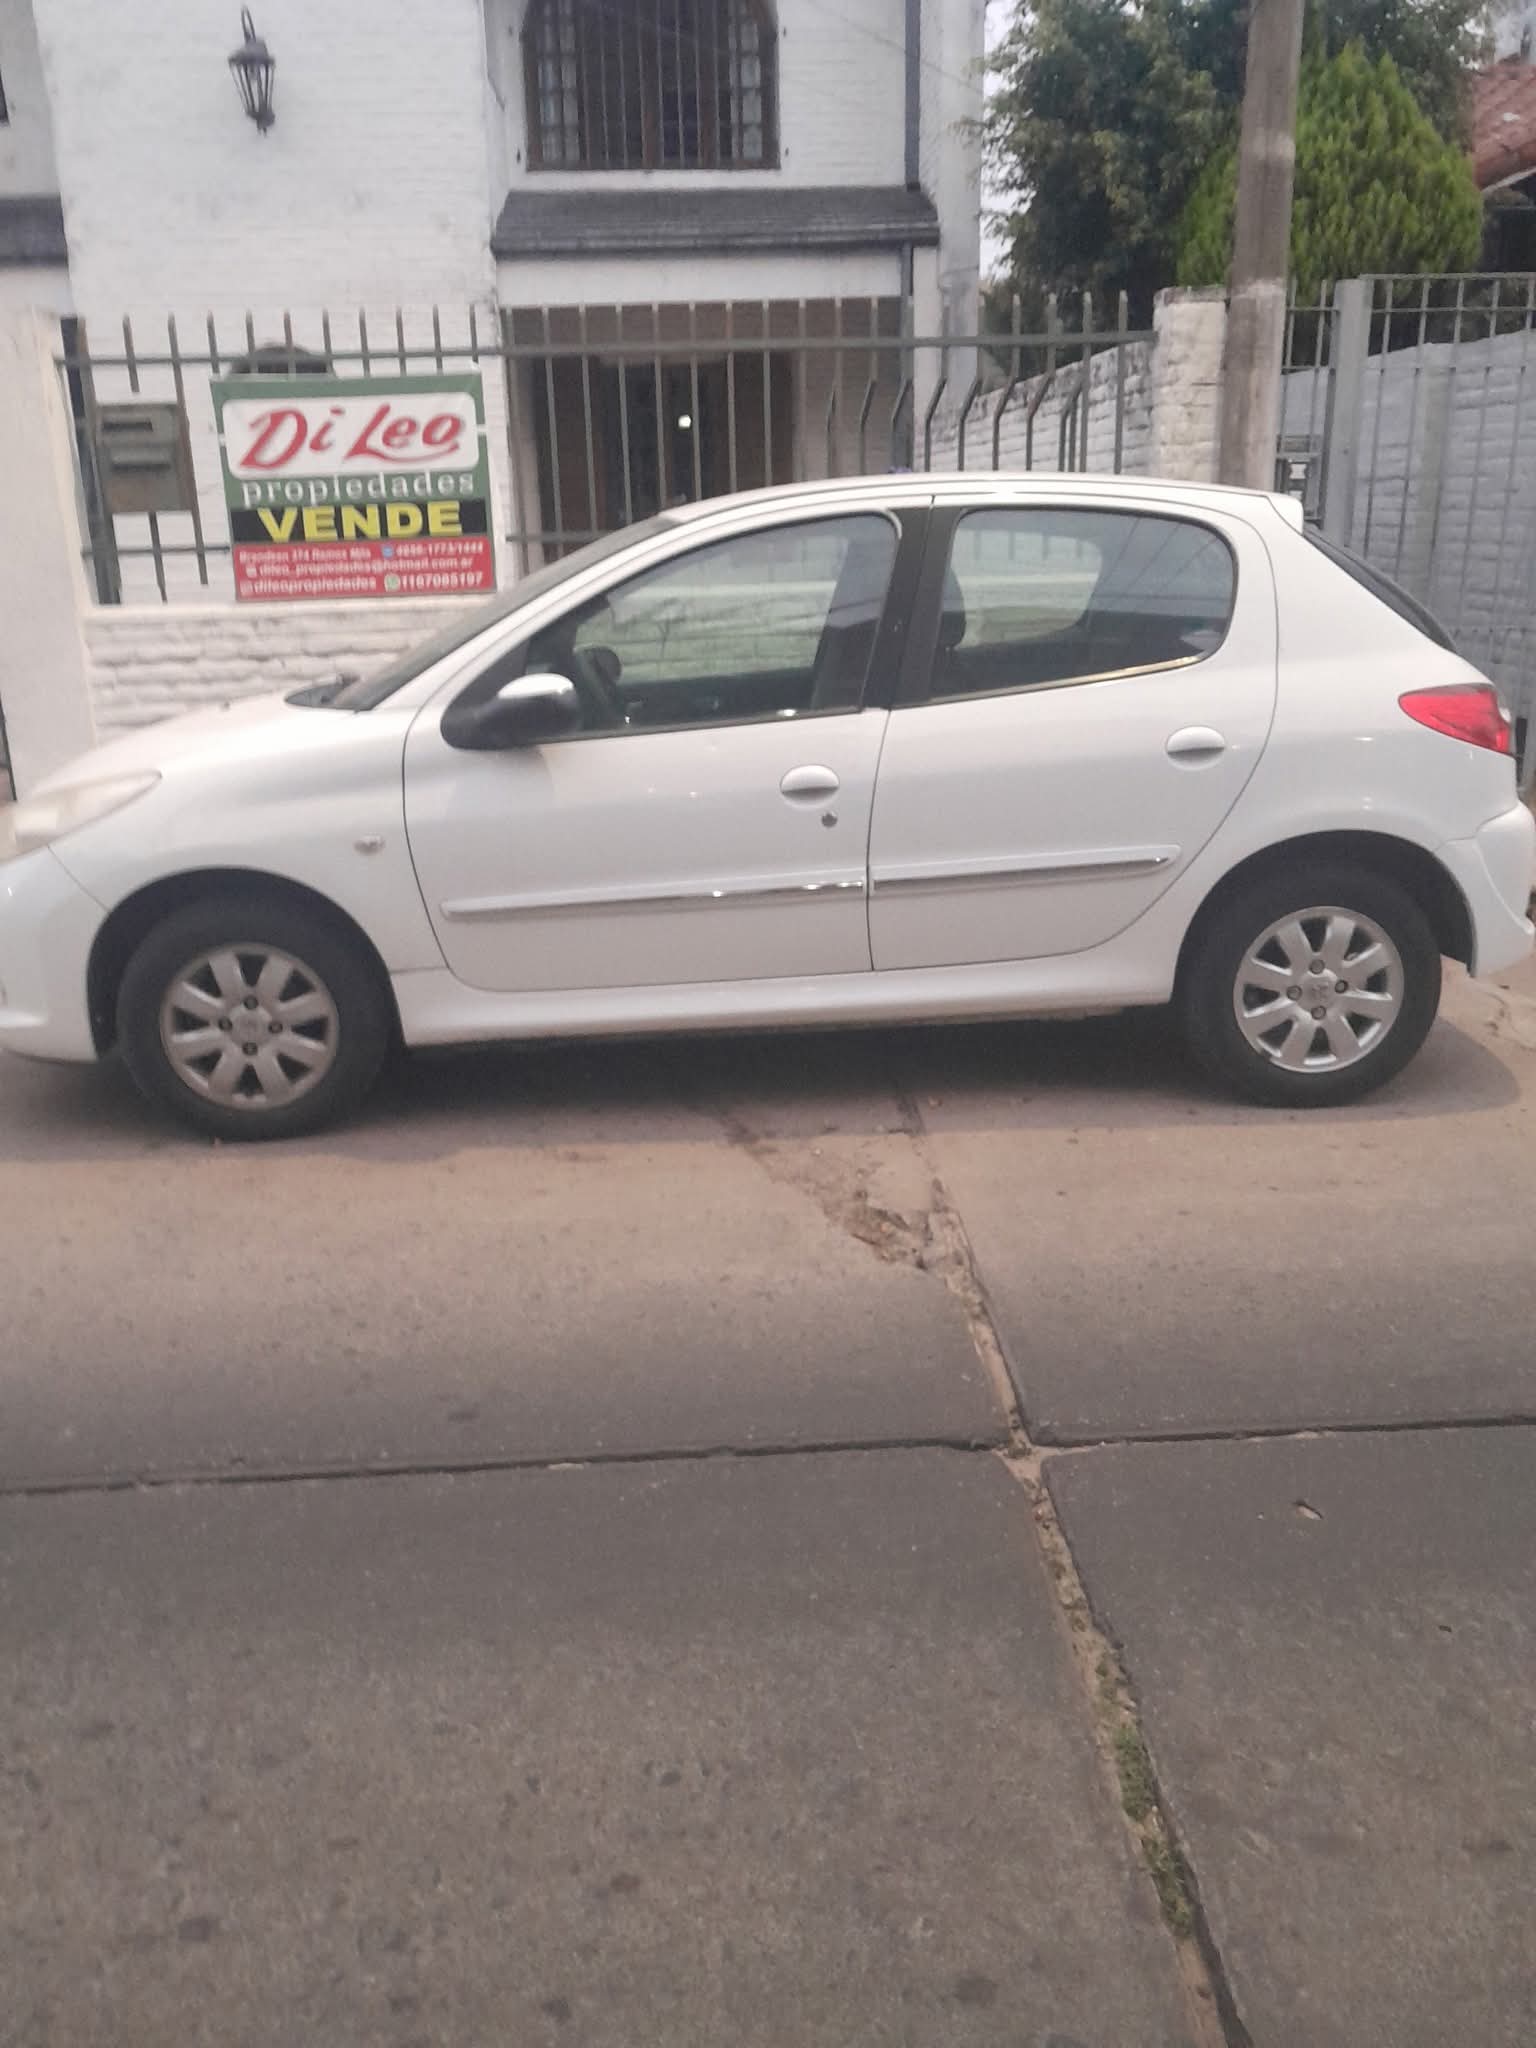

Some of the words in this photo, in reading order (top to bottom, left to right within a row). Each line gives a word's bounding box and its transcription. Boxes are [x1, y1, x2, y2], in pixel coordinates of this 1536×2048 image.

[240, 403, 346, 469] Di
[342, 402, 463, 463] Leo
[241, 471, 474, 510] propiedades
[256, 500, 463, 543] VENDE
